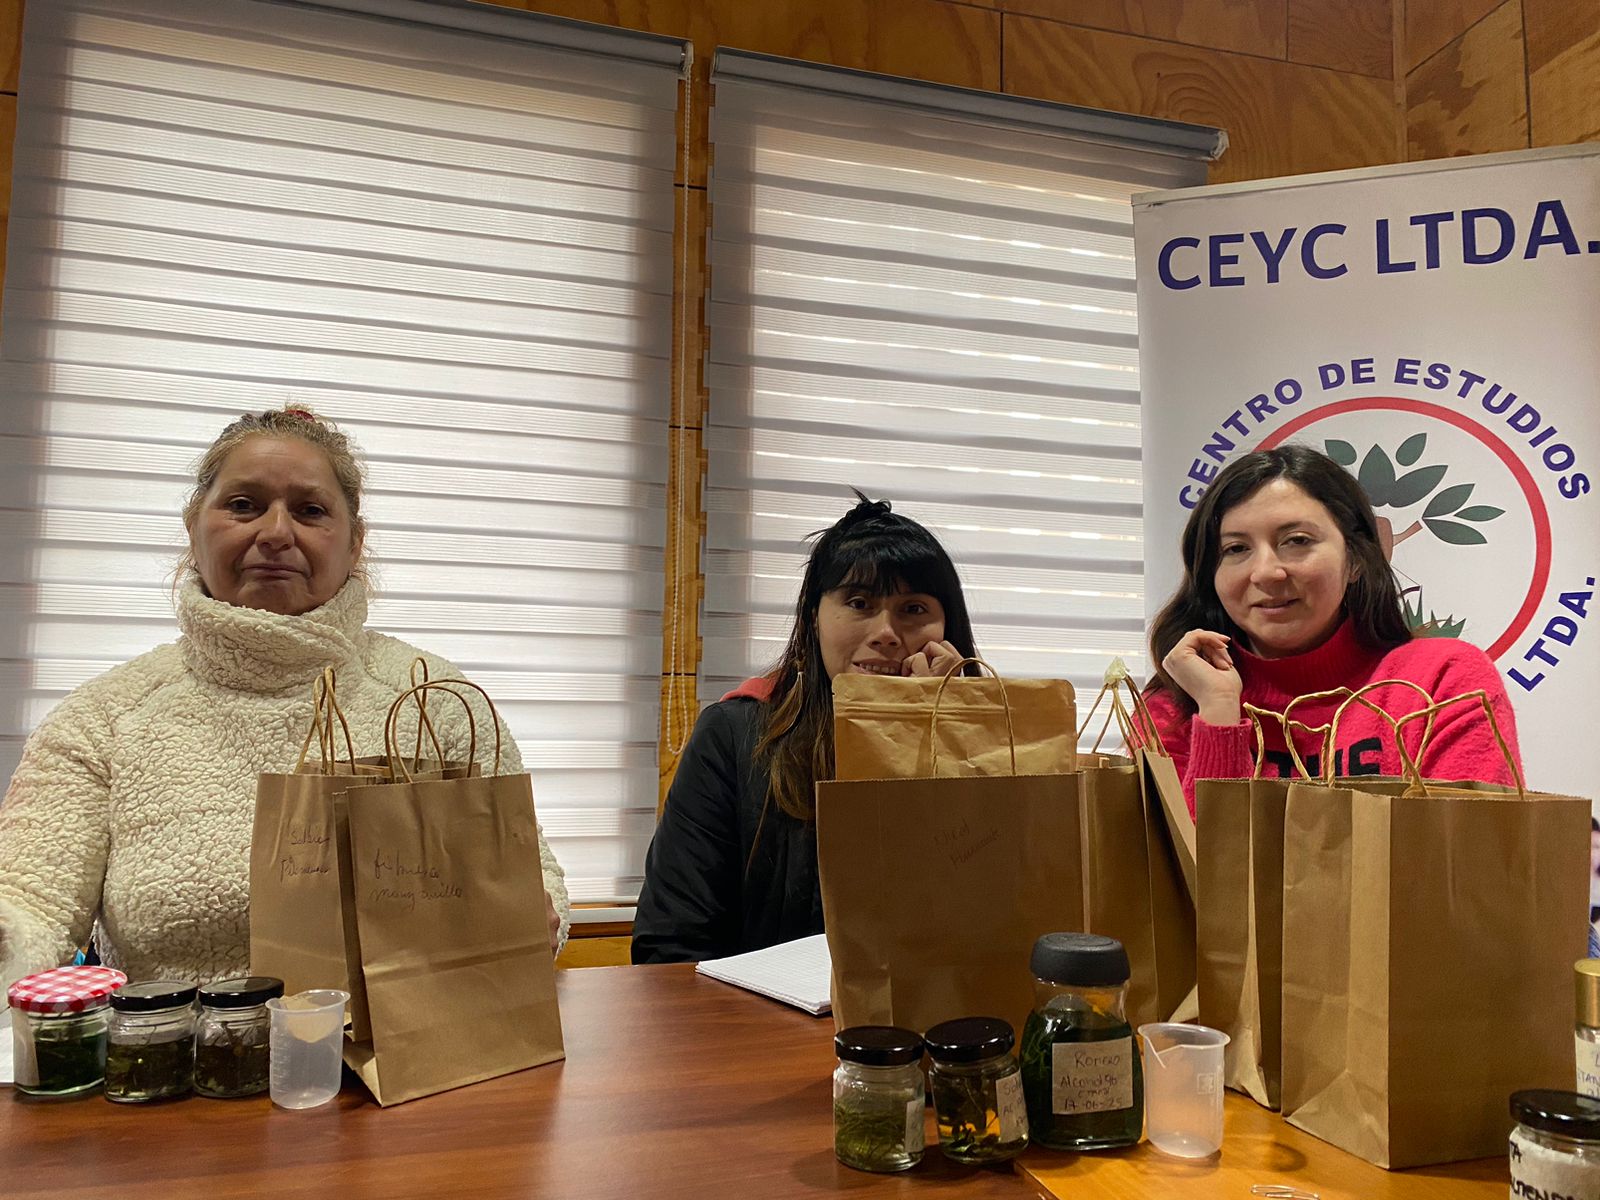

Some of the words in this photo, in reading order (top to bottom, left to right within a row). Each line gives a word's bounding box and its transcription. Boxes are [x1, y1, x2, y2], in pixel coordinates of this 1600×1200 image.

[1157, 223, 1349, 291] CEYC
[1375, 199, 1600, 275] LTDA.
[1178, 379, 1304, 510] CENTRO
[1318, 358, 1376, 391] DE
[1393, 358, 1591, 500] ESTUDIOS
[1506, 576, 1596, 692] LTDA.
